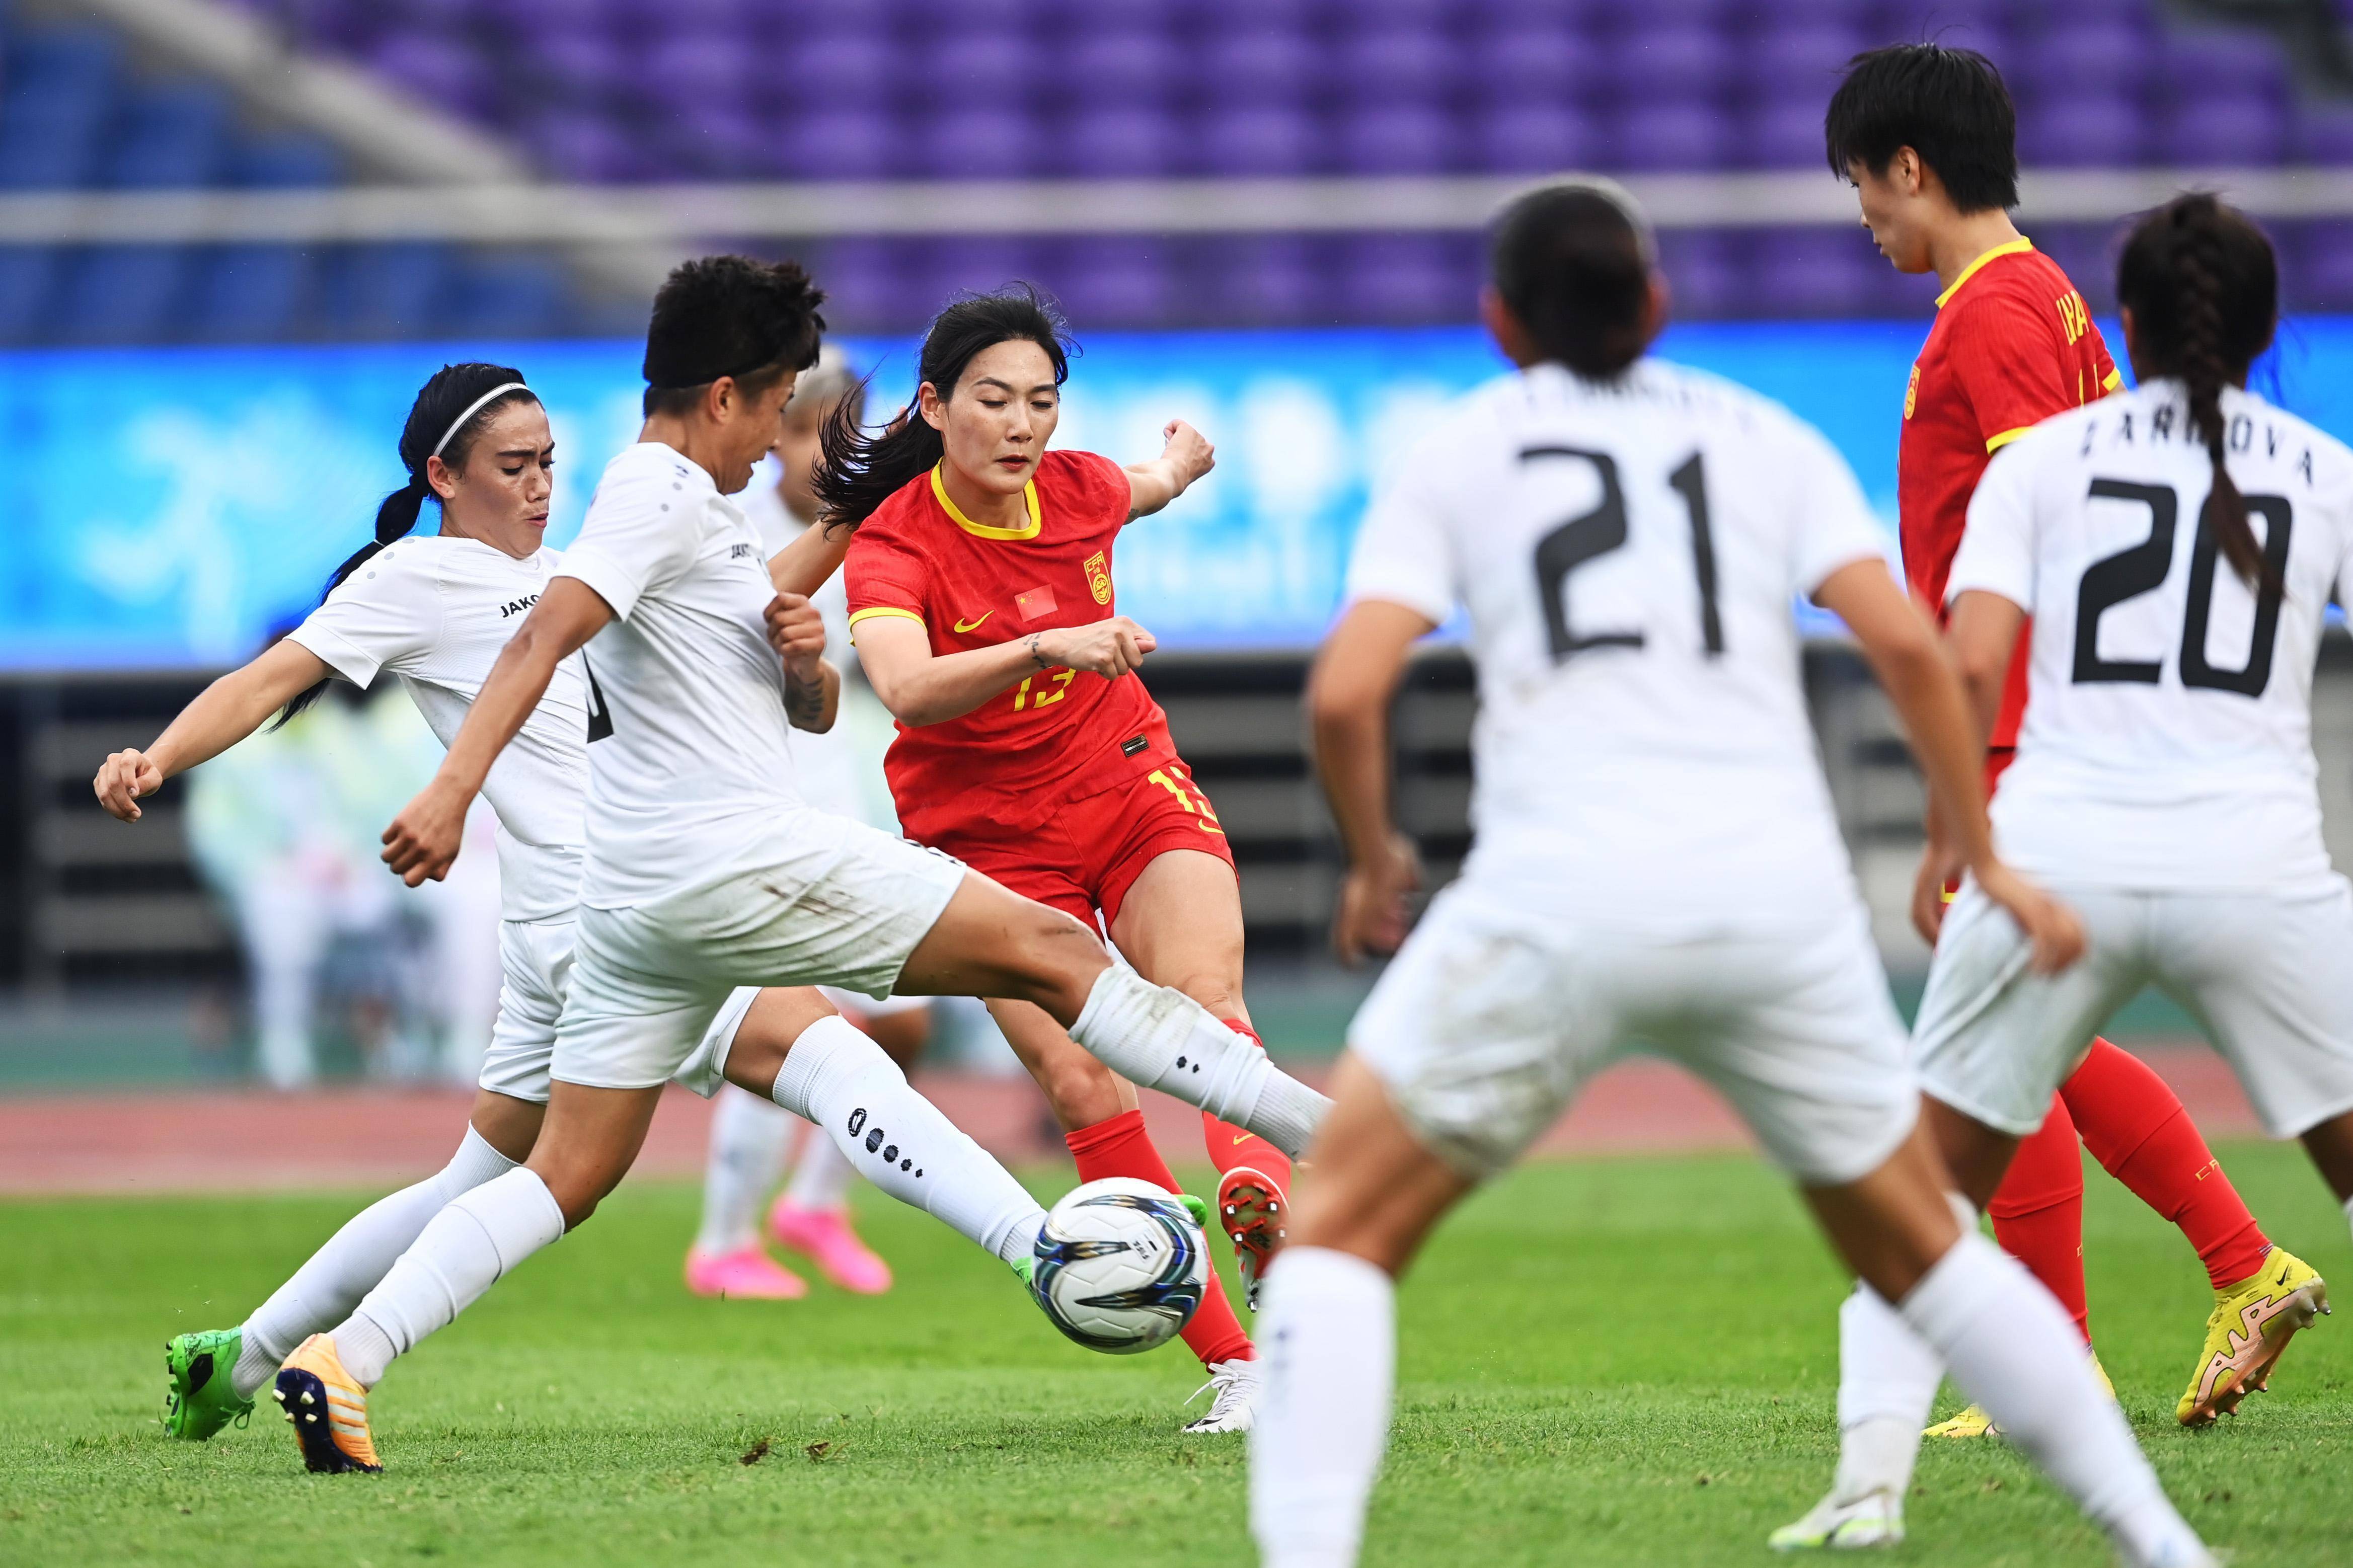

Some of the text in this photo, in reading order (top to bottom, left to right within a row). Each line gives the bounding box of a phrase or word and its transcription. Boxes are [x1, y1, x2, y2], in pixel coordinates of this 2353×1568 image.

[1086, 554, 1104, 573] CFA
[1516, 446, 1725, 666] 21
[2072, 476, 2292, 696] 20
